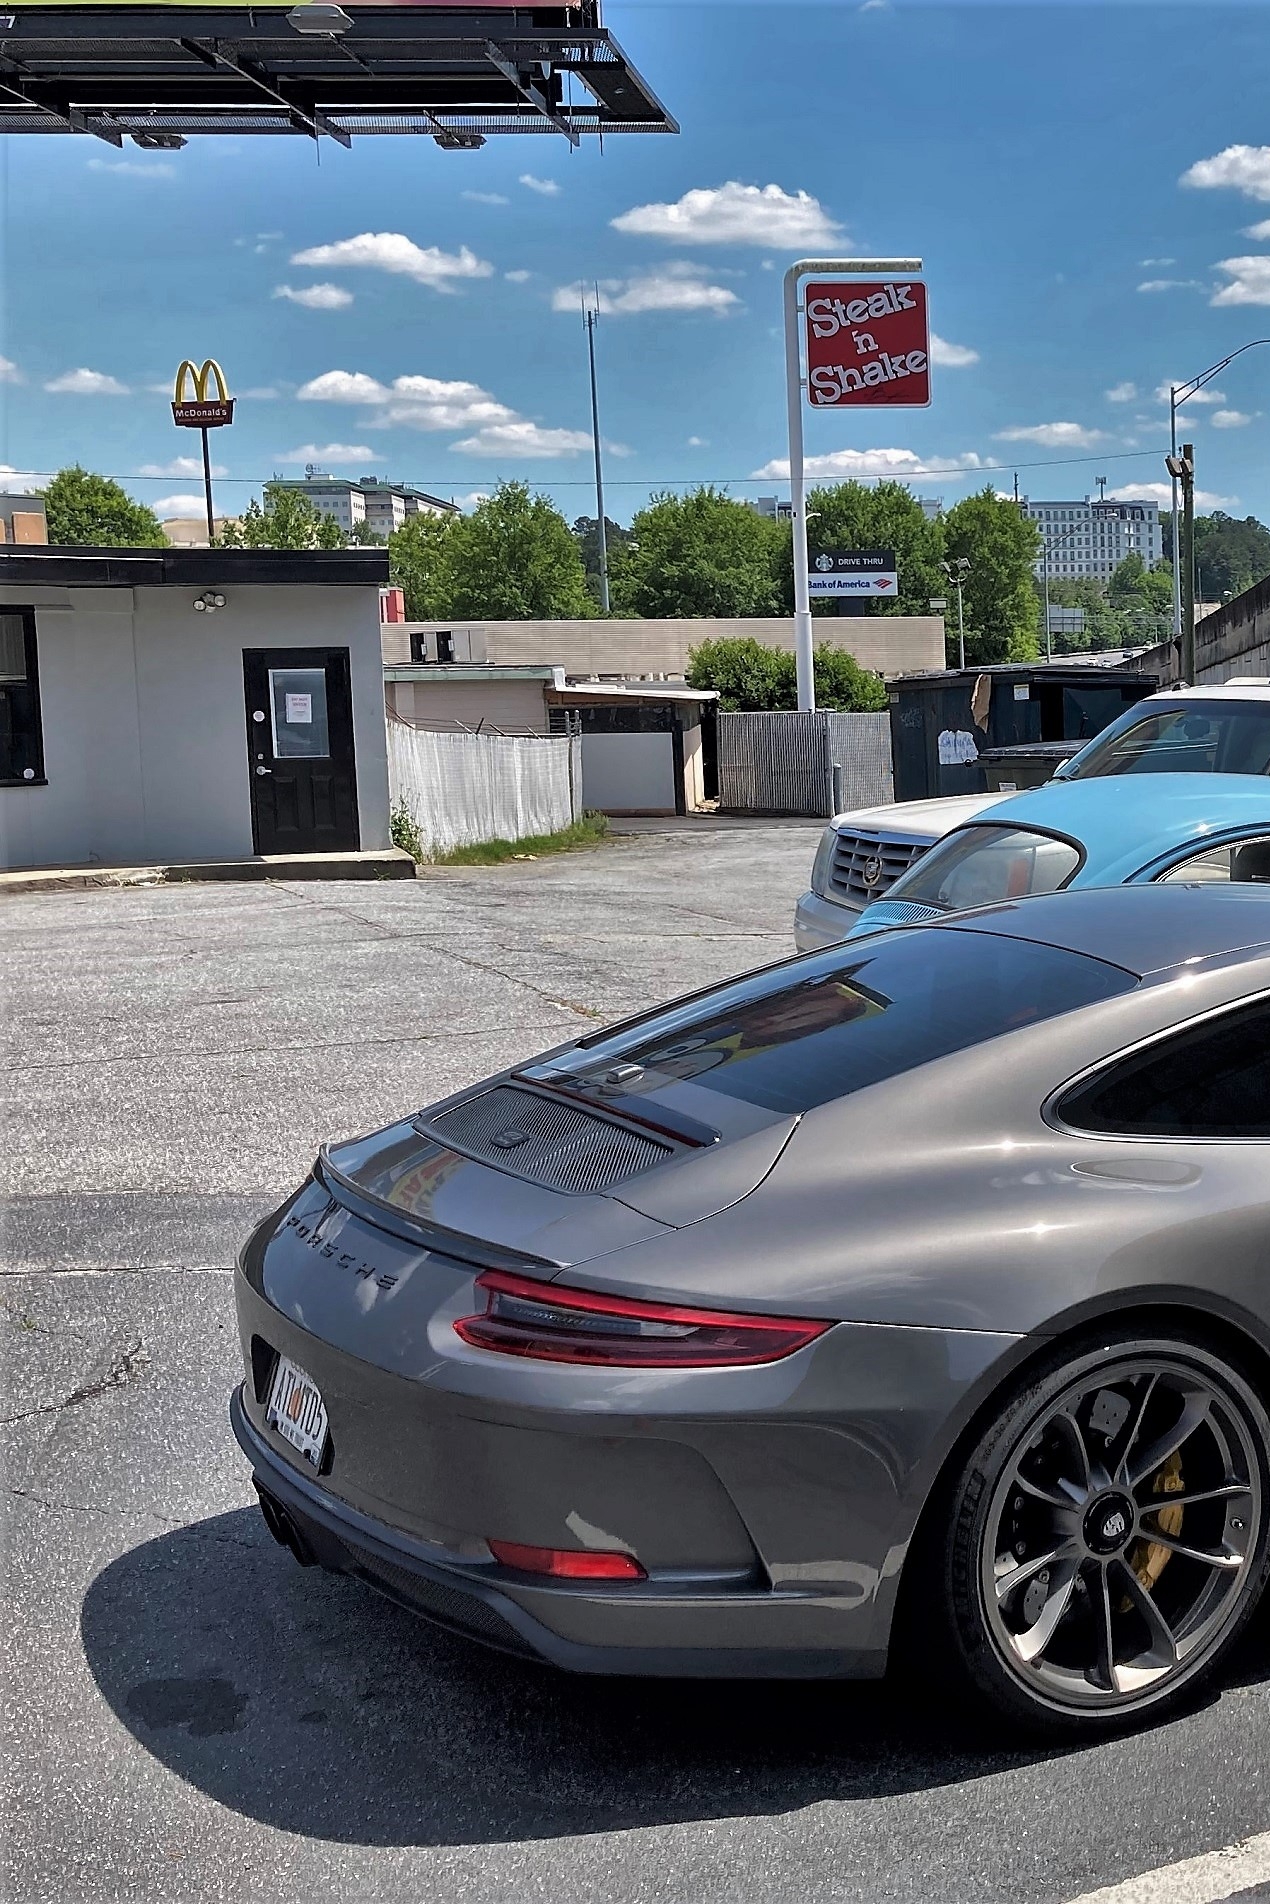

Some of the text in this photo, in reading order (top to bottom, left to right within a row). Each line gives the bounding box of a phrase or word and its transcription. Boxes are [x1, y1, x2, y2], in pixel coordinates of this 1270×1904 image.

[0, 15, 16, 29] 7
[807, 283, 917, 339] Steak
[810, 350, 928, 404] Shake
[175, 408, 227, 417] McDonald's
[838, 557, 884, 566] DRIVE THRU
[808, 579, 871, 589] Bank of America
[286, 1217, 399, 1290] PORSCHE
